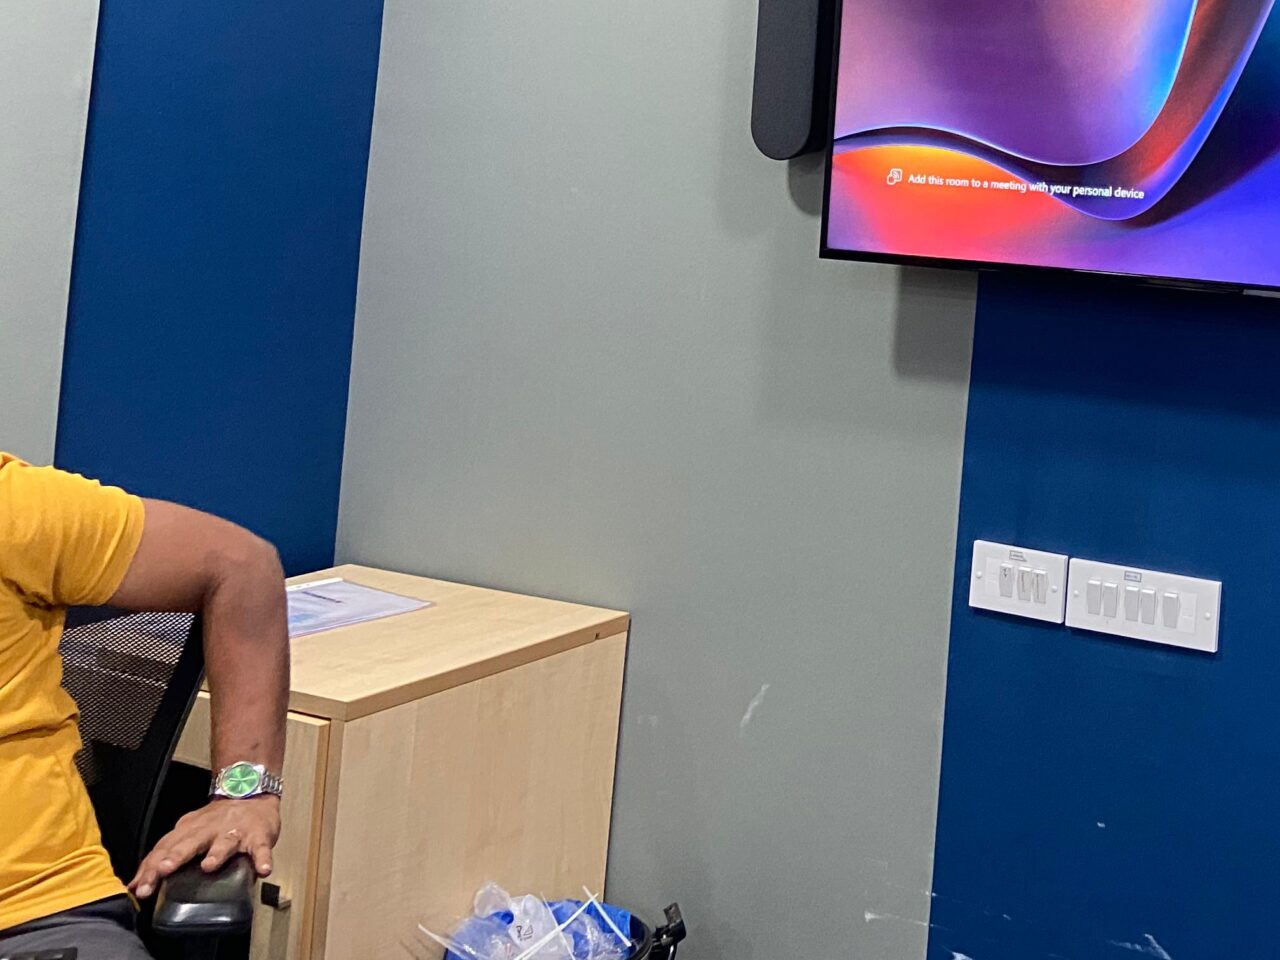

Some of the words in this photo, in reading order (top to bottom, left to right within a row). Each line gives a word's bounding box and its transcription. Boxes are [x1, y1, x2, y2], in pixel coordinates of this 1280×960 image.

[908, 174, 926, 184] Add
[928, 175, 944, 185] this
[946, 178, 969, 187] room
[971, 178, 981, 187] to
[983, 180, 989, 188] a
[990, 180, 1027, 193] meeting
[1029, 182, 1048, 193] with
[1049, 184, 1072, 196] your
[1072, 185, 1112, 197] personal
[1114, 187, 1145, 199] device
